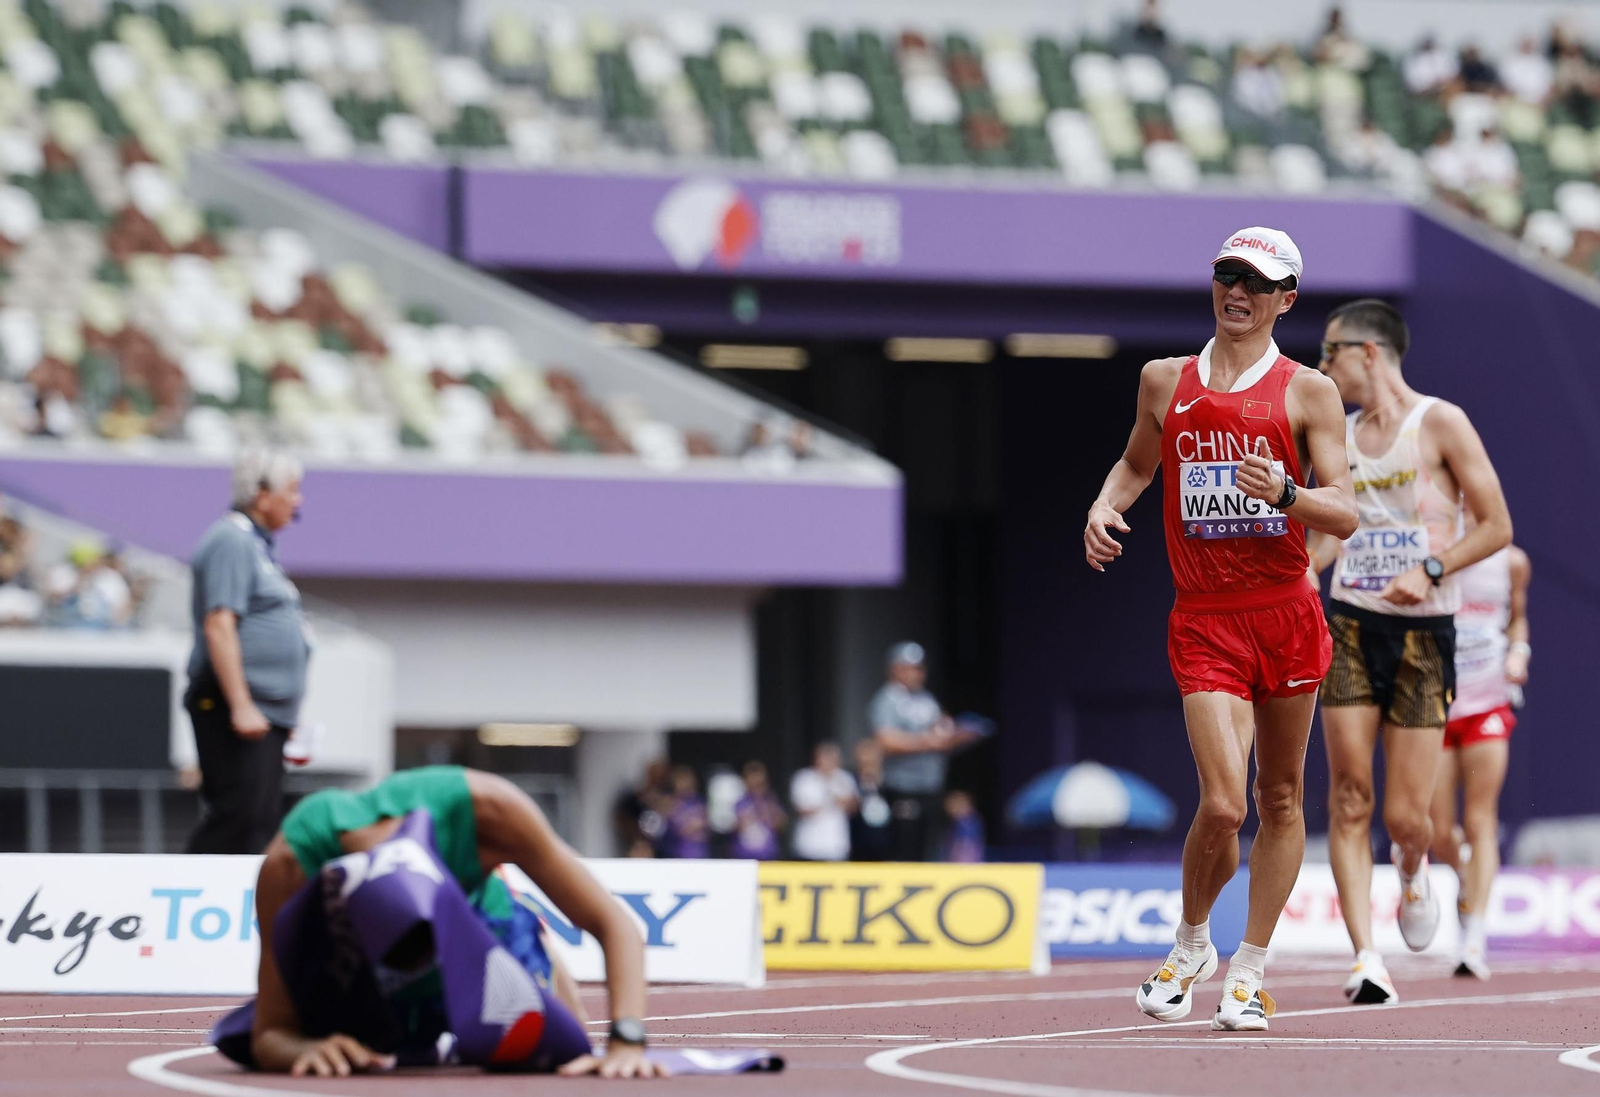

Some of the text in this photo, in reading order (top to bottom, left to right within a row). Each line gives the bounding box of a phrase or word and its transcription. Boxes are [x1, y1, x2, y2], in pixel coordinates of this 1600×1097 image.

[1231, 237, 1277, 256] CHINA
[1184, 493, 1261, 517] WANG
[1365, 531, 1419, 549] TDK
[1486, 873, 1600, 937] DK
[0, 884, 142, 975] kyo
